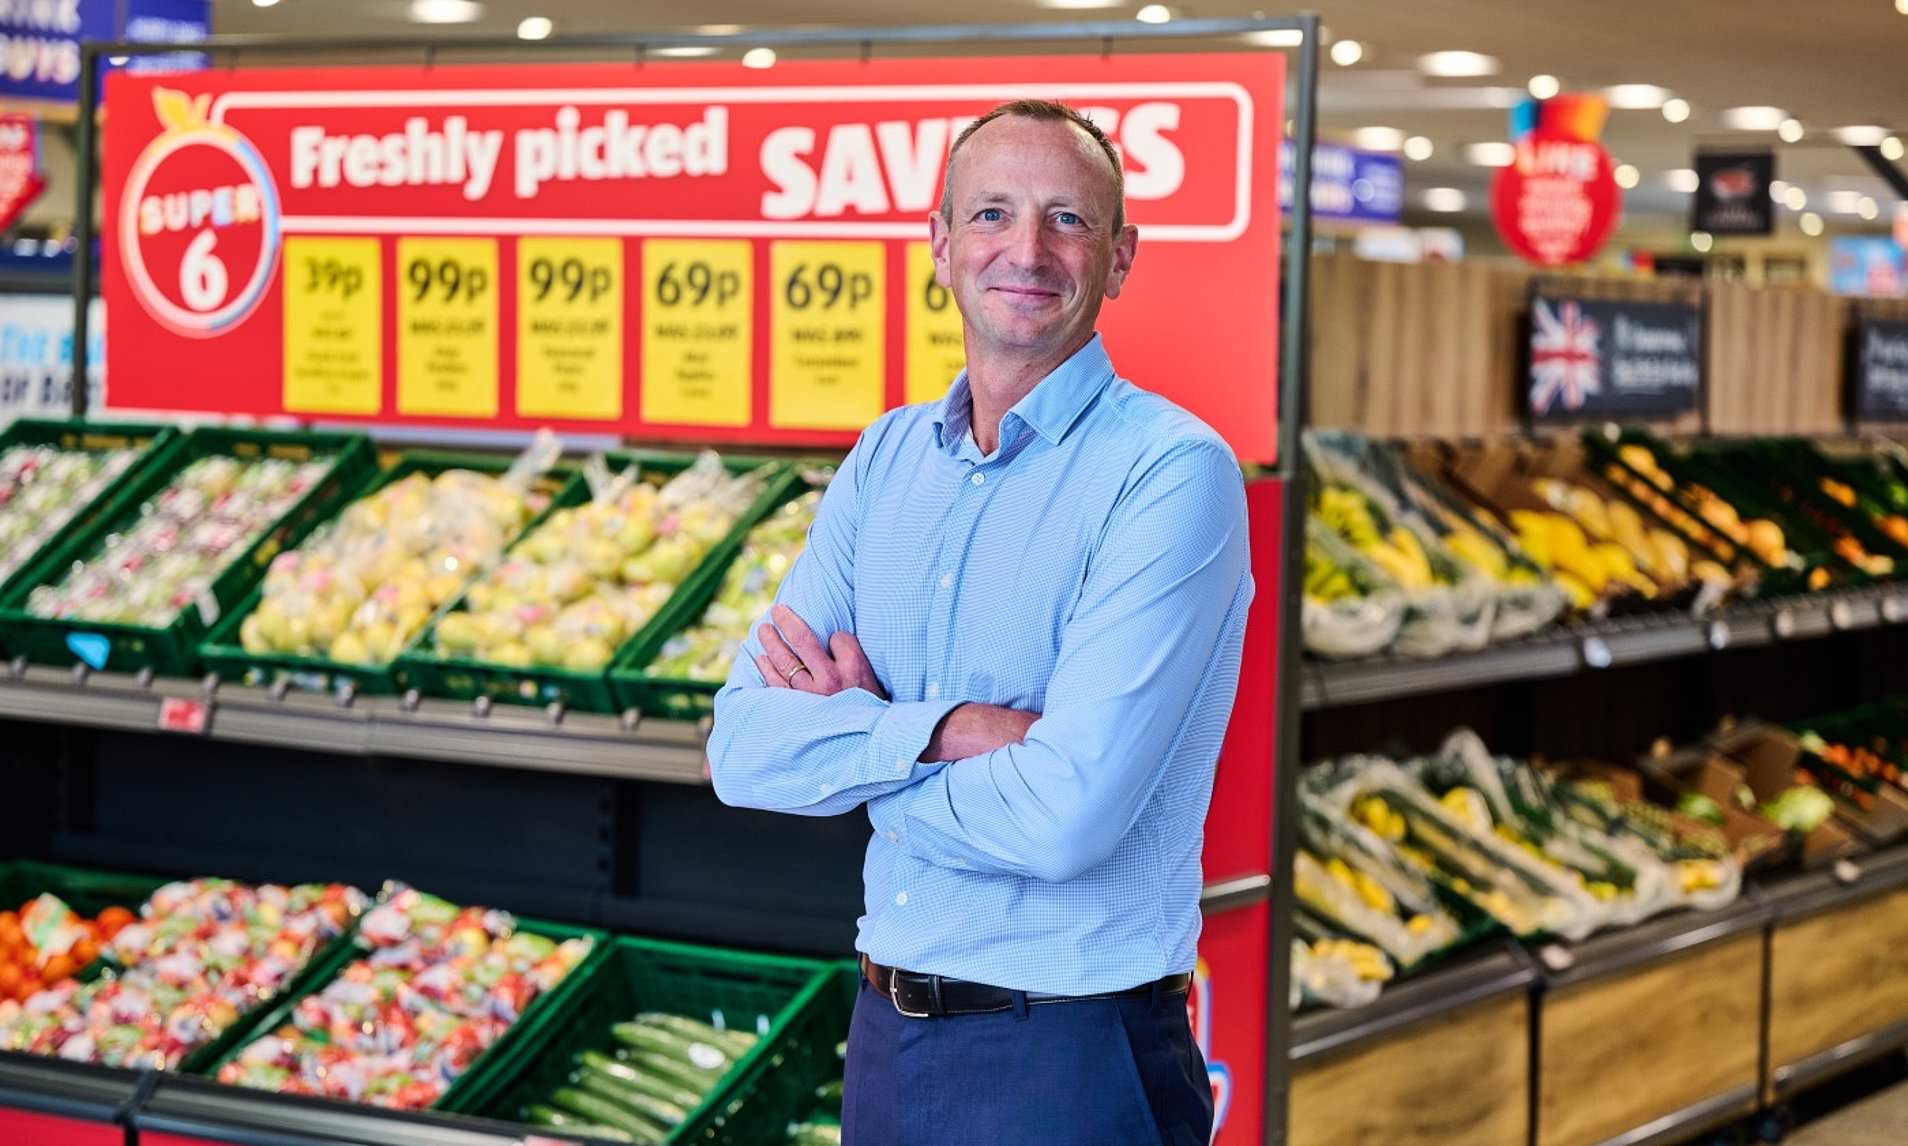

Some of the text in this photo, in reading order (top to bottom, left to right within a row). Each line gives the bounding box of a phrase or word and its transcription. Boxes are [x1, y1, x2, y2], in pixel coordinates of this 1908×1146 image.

[290, 116, 504, 200] Freshly
[514, 105, 729, 199] picked
[759, 102, 1186, 219] SAVS
[139, 183, 262, 235] SUPER
[179, 228, 228, 312] 6
[303, 255, 364, 302] 39p
[408, 257, 489, 305] 99p
[529, 257, 613, 305] 99p
[655, 261, 740, 308] 69p
[785, 264, 872, 313] 69p
